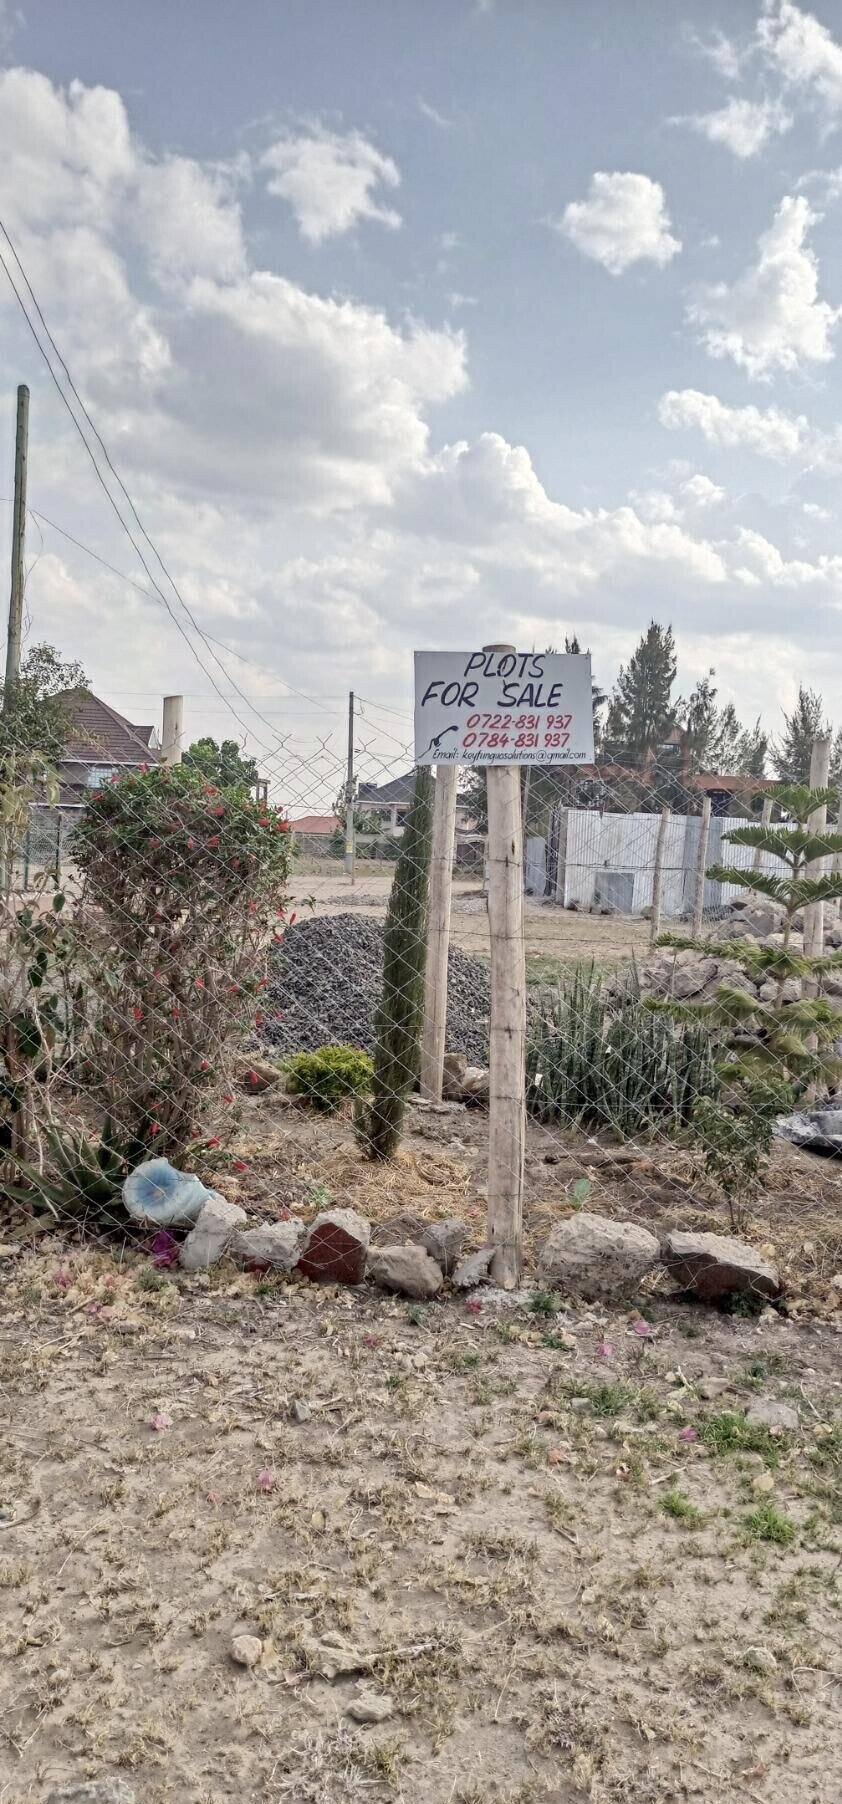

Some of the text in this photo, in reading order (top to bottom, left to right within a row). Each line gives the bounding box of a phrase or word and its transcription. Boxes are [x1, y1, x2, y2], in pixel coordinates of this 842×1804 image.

[463, 652, 546, 678] PLOTS
[421, 681, 564, 707] FOR SALE
[466, 714, 573, 730] 0722-831 937
[462, 732, 571, 748] 0784-831 937
[432, 748, 459, 760] Email:
